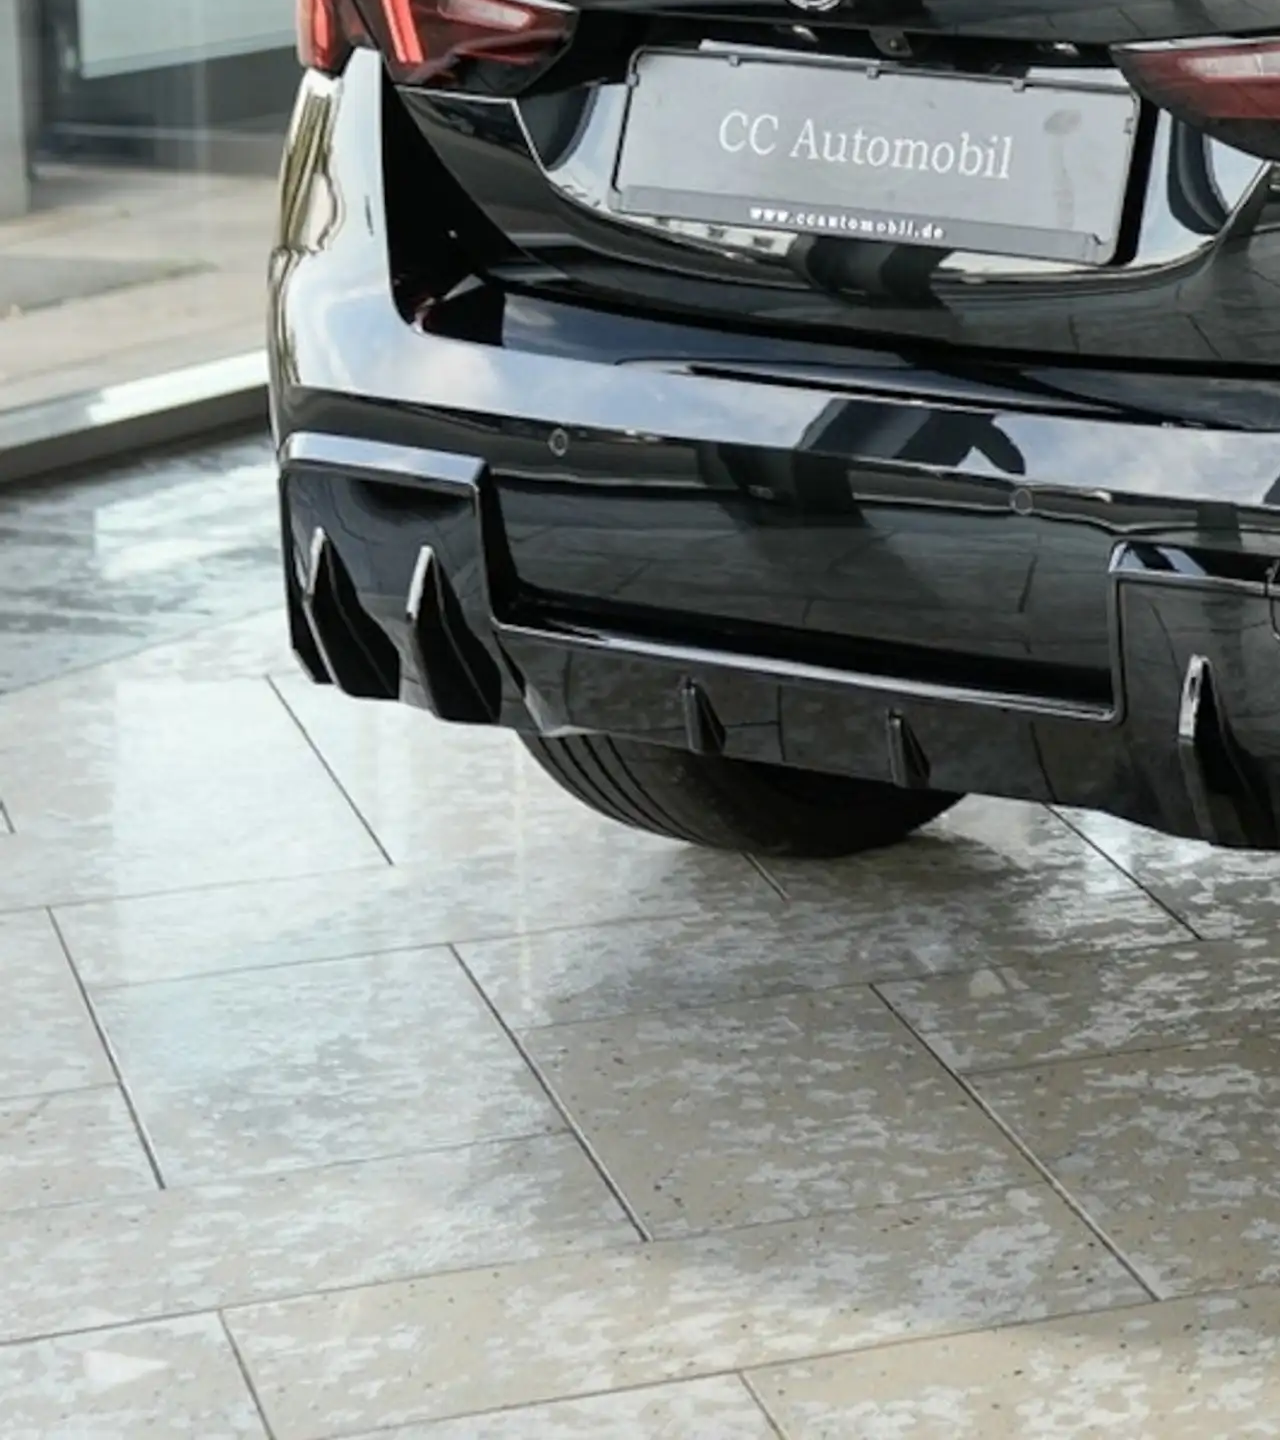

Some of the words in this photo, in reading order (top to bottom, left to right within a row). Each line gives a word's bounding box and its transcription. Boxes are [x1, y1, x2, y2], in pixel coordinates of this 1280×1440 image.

[718, 109, 779, 156] CC
[789, 117, 1014, 180] Automobil
[750, 207, 946, 240] www.ccautomobil.de
